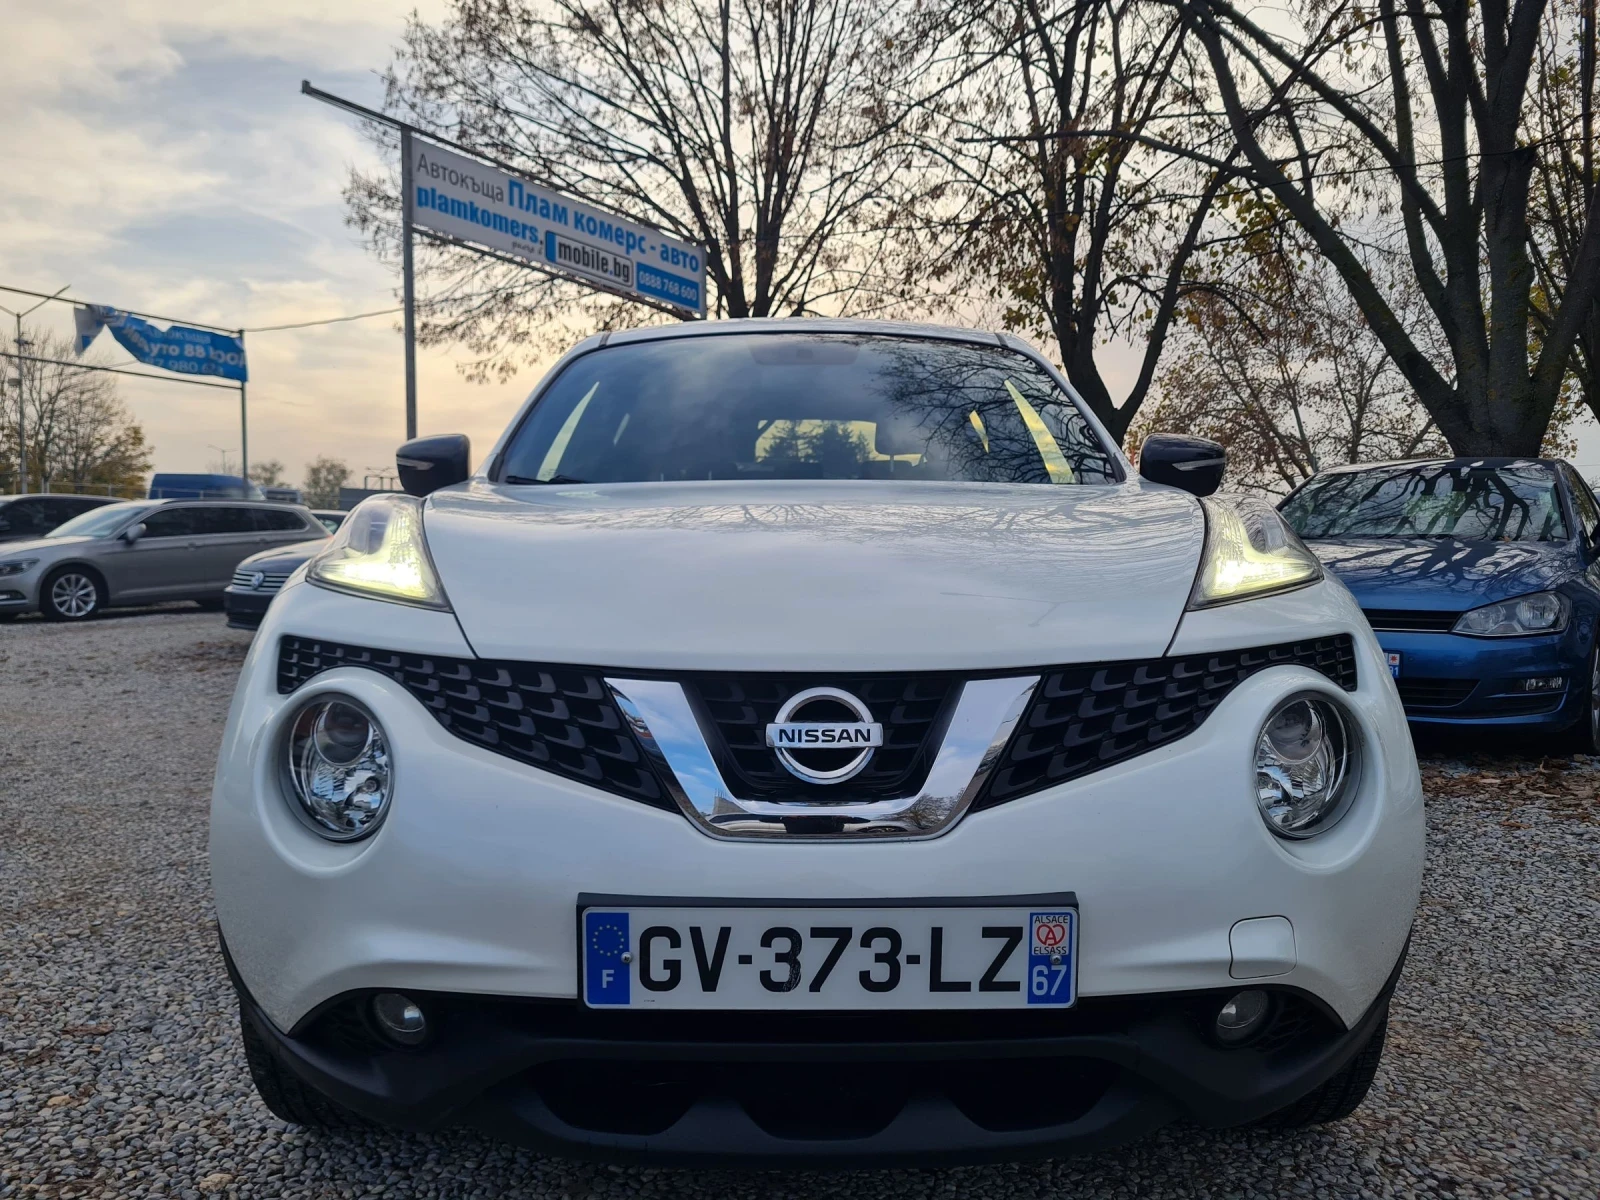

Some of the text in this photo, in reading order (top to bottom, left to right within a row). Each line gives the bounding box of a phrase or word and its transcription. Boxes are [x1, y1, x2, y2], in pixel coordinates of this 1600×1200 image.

[416, 153, 504, 203] Автокъща
[508, 179, 568, 226] Плам
[573, 211, 647, 255] комерс
[660, 243, 699, 272] авто
[639, 271, 661, 289] 0888
[663, 279, 680, 295] 768
[184, 343, 206, 358] 88
[778, 728, 871, 743] NISSAN
[1034, 915, 1068, 924] ALSACE
[639, 925, 1024, 993] GV-373-LZ
[1033, 946, 1067, 955] ELSASS
[602, 969, 615, 989] F
[1032, 964, 1067, 996] 67
